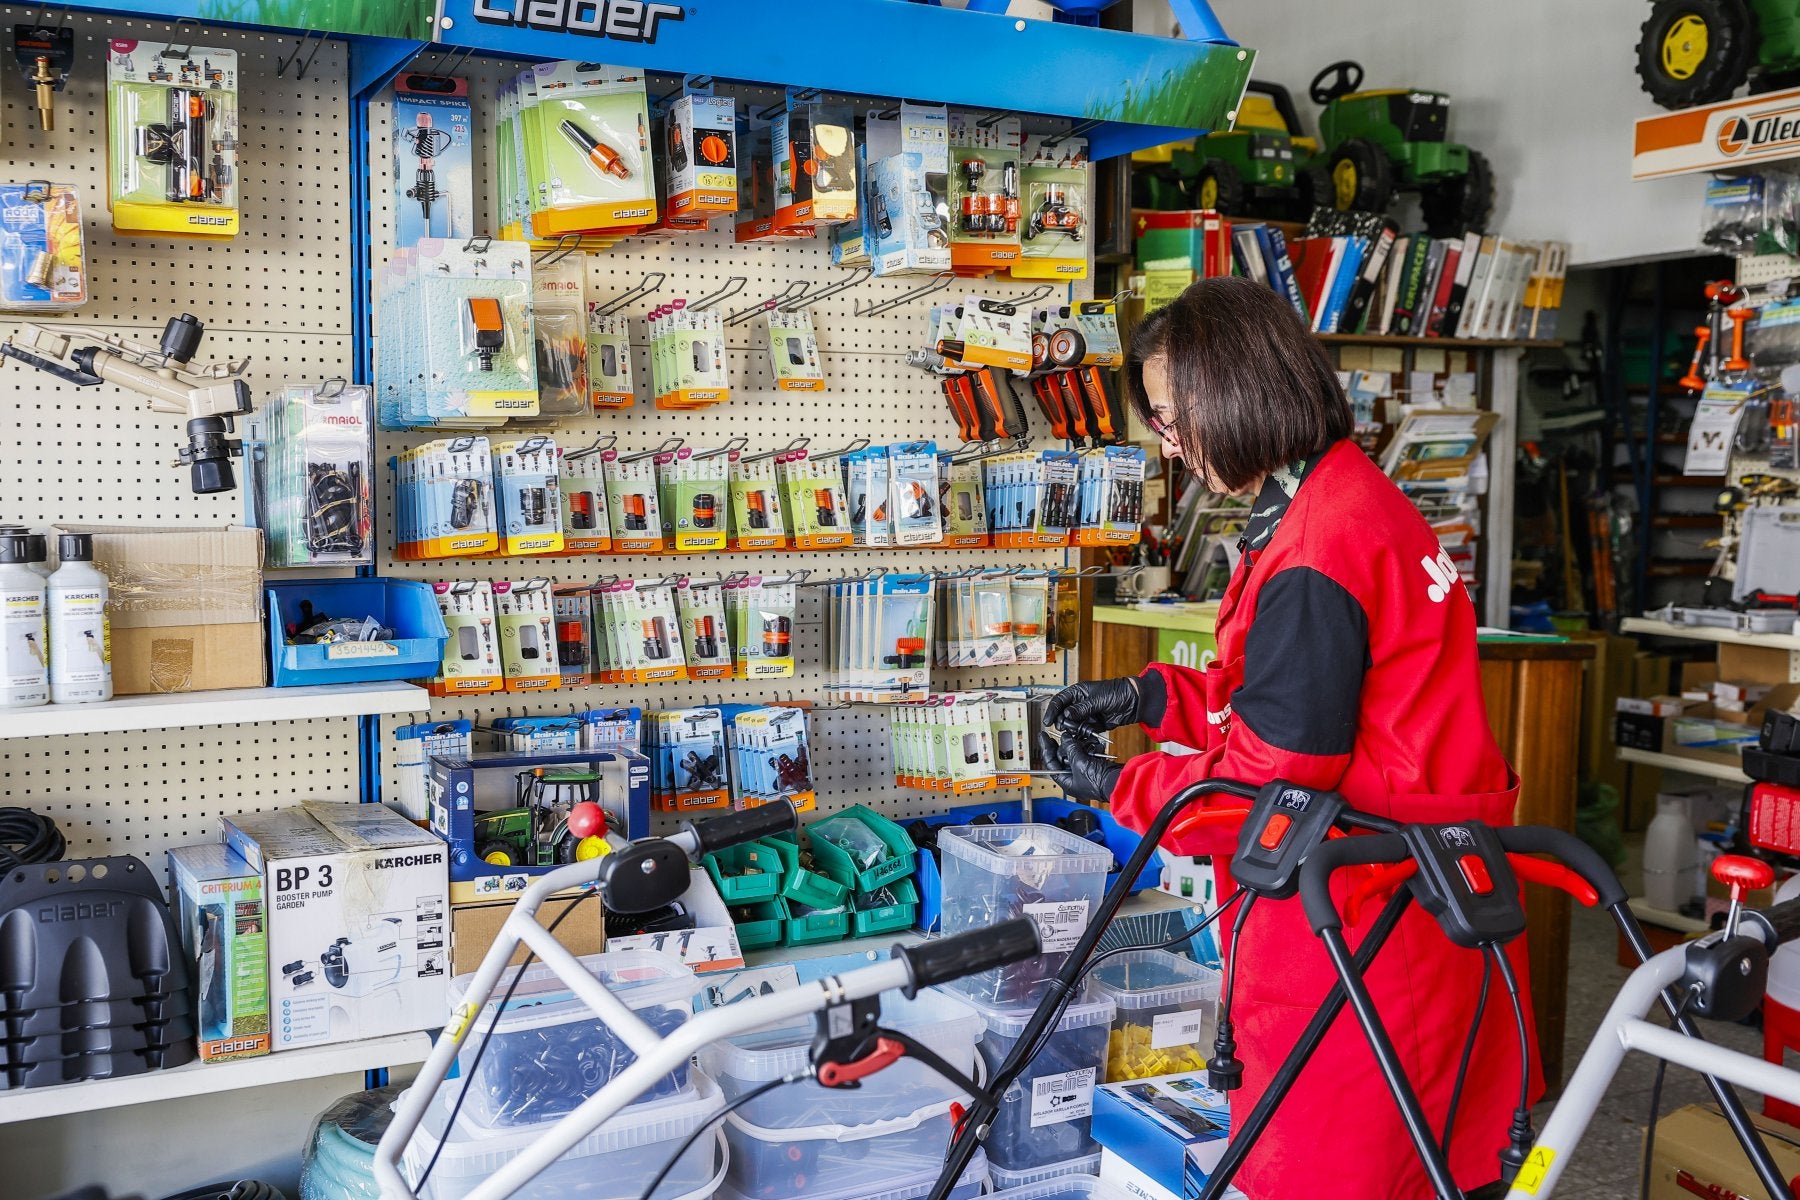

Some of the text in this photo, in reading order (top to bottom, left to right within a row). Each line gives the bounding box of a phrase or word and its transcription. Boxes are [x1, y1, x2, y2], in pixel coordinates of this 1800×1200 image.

[400, 96, 437, 105] IMPACT
[451, 114, 462, 122] 397
[698, 195, 734, 204] claber
[786, 380, 817, 389] claber
[687, 391, 721, 400] claber
[494, 399, 535, 409] claber
[450, 538, 488, 549] claber
[519, 538, 554, 549] claber
[568, 540, 602, 549] claber
[621, 540, 653, 549] claber
[683, 537, 719, 546] claber
[747, 538, 777, 546] claber
[816, 536, 844, 544] claber
[646, 669, 679, 678] claber
[696, 668, 725, 677] claber
[755, 665, 788, 674] claber
[456, 679, 494, 689] claber
[516, 679, 551, 689] claber
[960, 779, 989, 791] claber
[683, 795, 720, 806] claber
[277, 864, 333, 892] BP 3
[201, 883, 252, 895] CRITERIUM
[276, 890, 333, 903] BOOSTER PUMP
[276, 901, 305, 911] GARDEN
[39, 901, 125, 923] claber
[210, 1038, 265, 1055] claber
